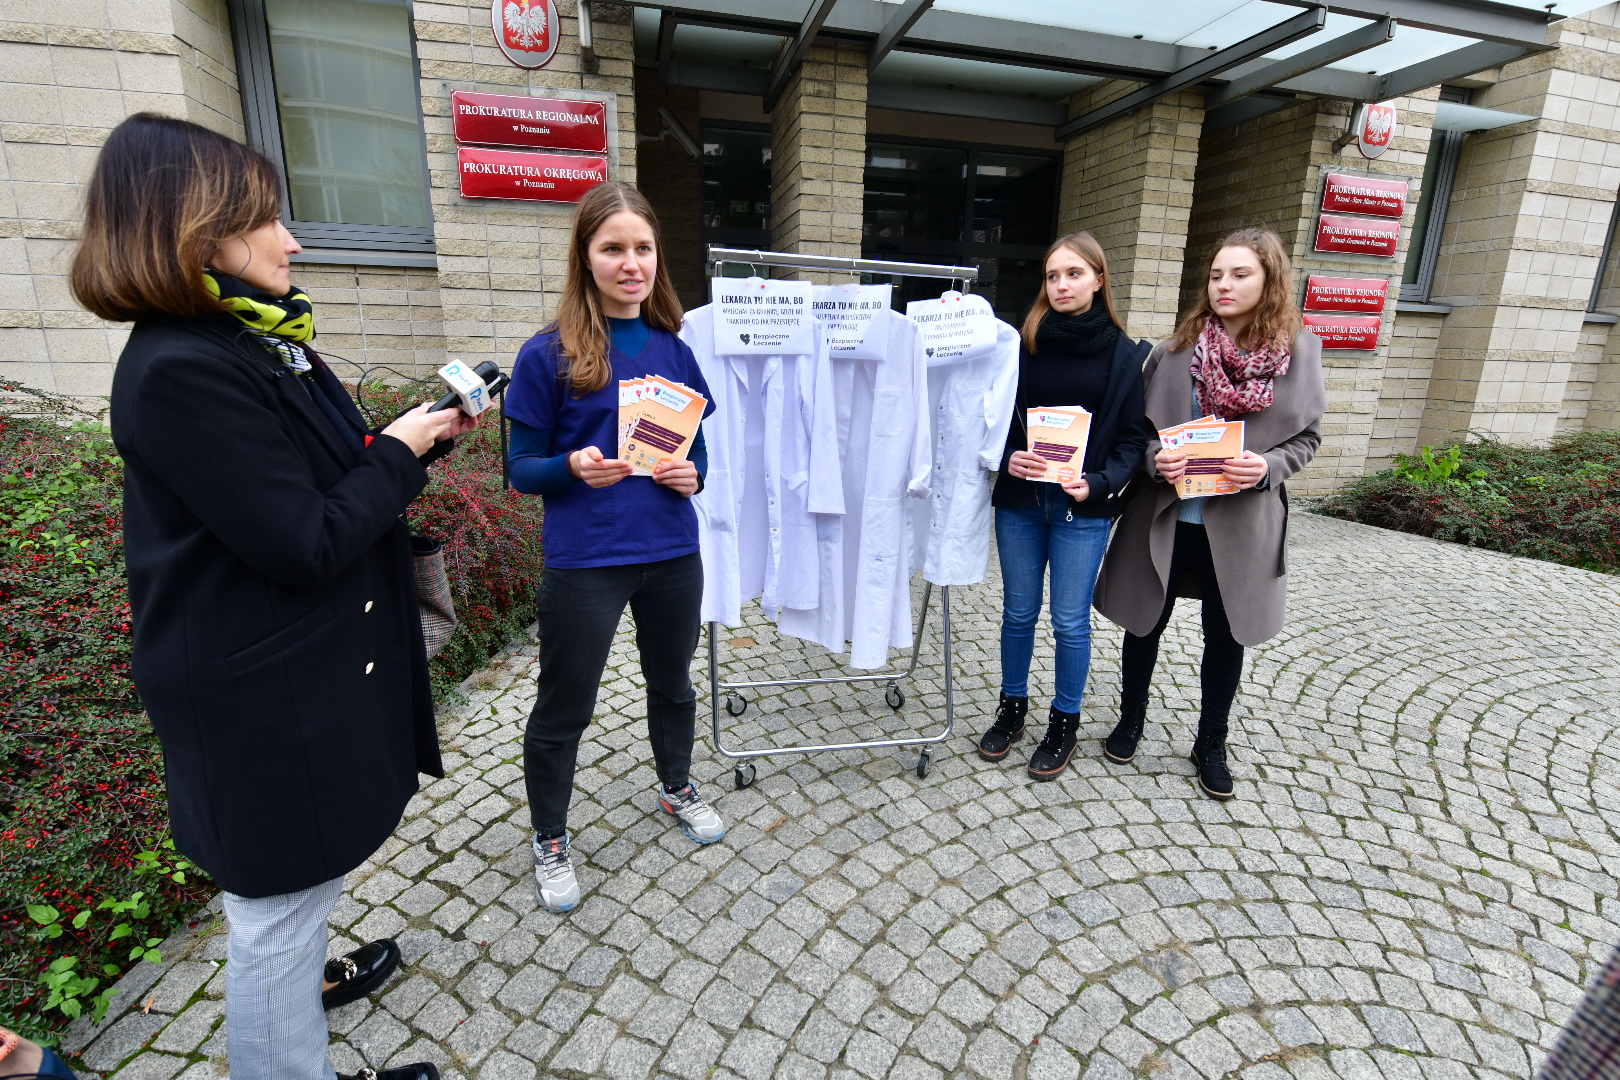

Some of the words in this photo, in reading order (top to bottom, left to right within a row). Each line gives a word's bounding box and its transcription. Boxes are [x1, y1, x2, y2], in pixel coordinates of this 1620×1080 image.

[459, 104, 533, 119] PROKURATURA
[535, 110, 599, 125] REGIONALNA
[520, 124, 550, 134] Poznaniu
[463, 162, 541, 177] PROKURATURA
[543, 167, 603, 182] OKRĘGOWA
[523, 178, 555, 189] Poznaniu
[1329, 184, 1375, 197] PROKURATURA
[1322, 225, 1367, 237] PROKURATURA
[1311, 286, 1355, 296] PROKURATURA
[721, 295, 752, 305] LEKARZA
[754, 296, 763, 305] TU
[765, 296, 777, 305] NIE
[778, 296, 792, 306] MA,
[793, 296, 804, 305] BO
[812, 301, 836, 310] EKARZA
[838, 301, 847, 310] TU
[848, 301, 859, 310] NIE
[872, 301, 882, 310] BO
[944, 312, 953, 321] TU
[954, 309, 965, 319] NIE
[753, 333, 790, 341] Bezpieczne
